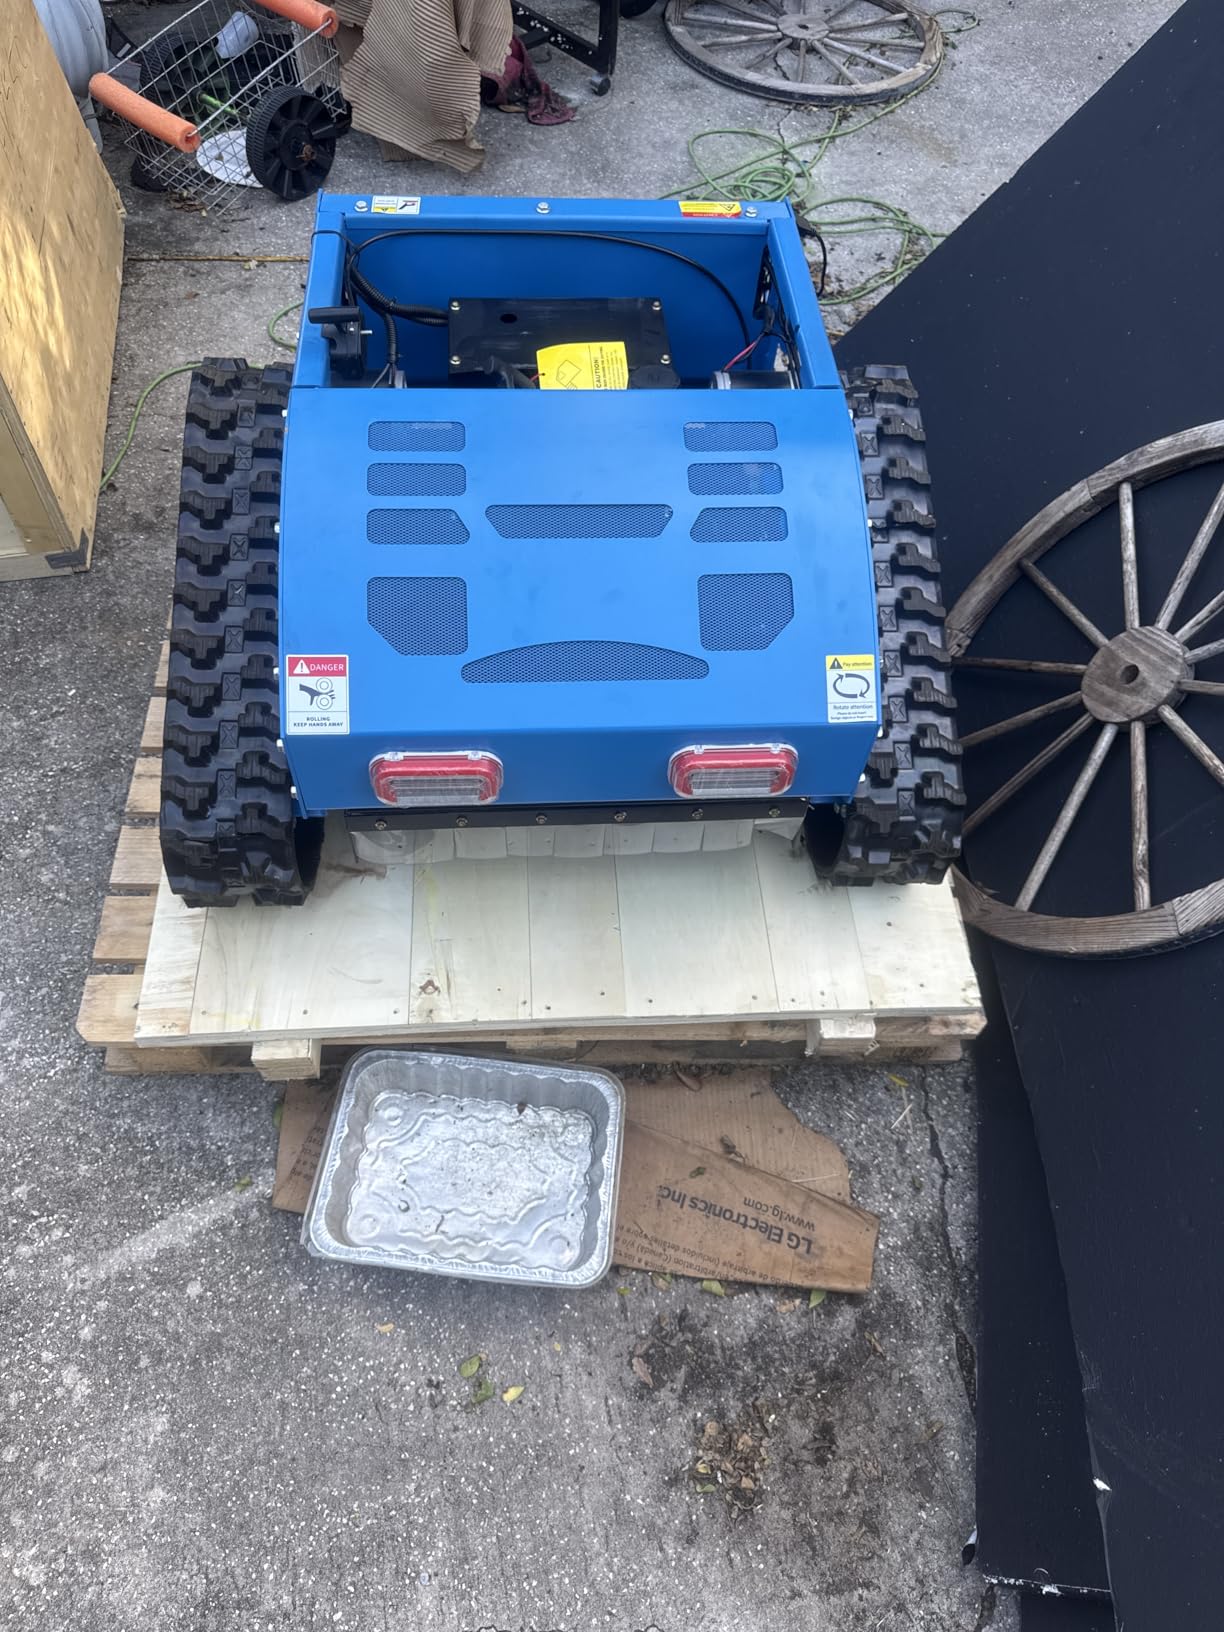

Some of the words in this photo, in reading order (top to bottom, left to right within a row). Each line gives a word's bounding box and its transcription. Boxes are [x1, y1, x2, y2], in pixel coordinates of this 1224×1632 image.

[310, 664, 344, 672] DANGER
[688, 1197, 784, 1244] Electronics
[743, 1196, 815, 1232] www.lg.com
[787, 1232, 813, 1254] LG
